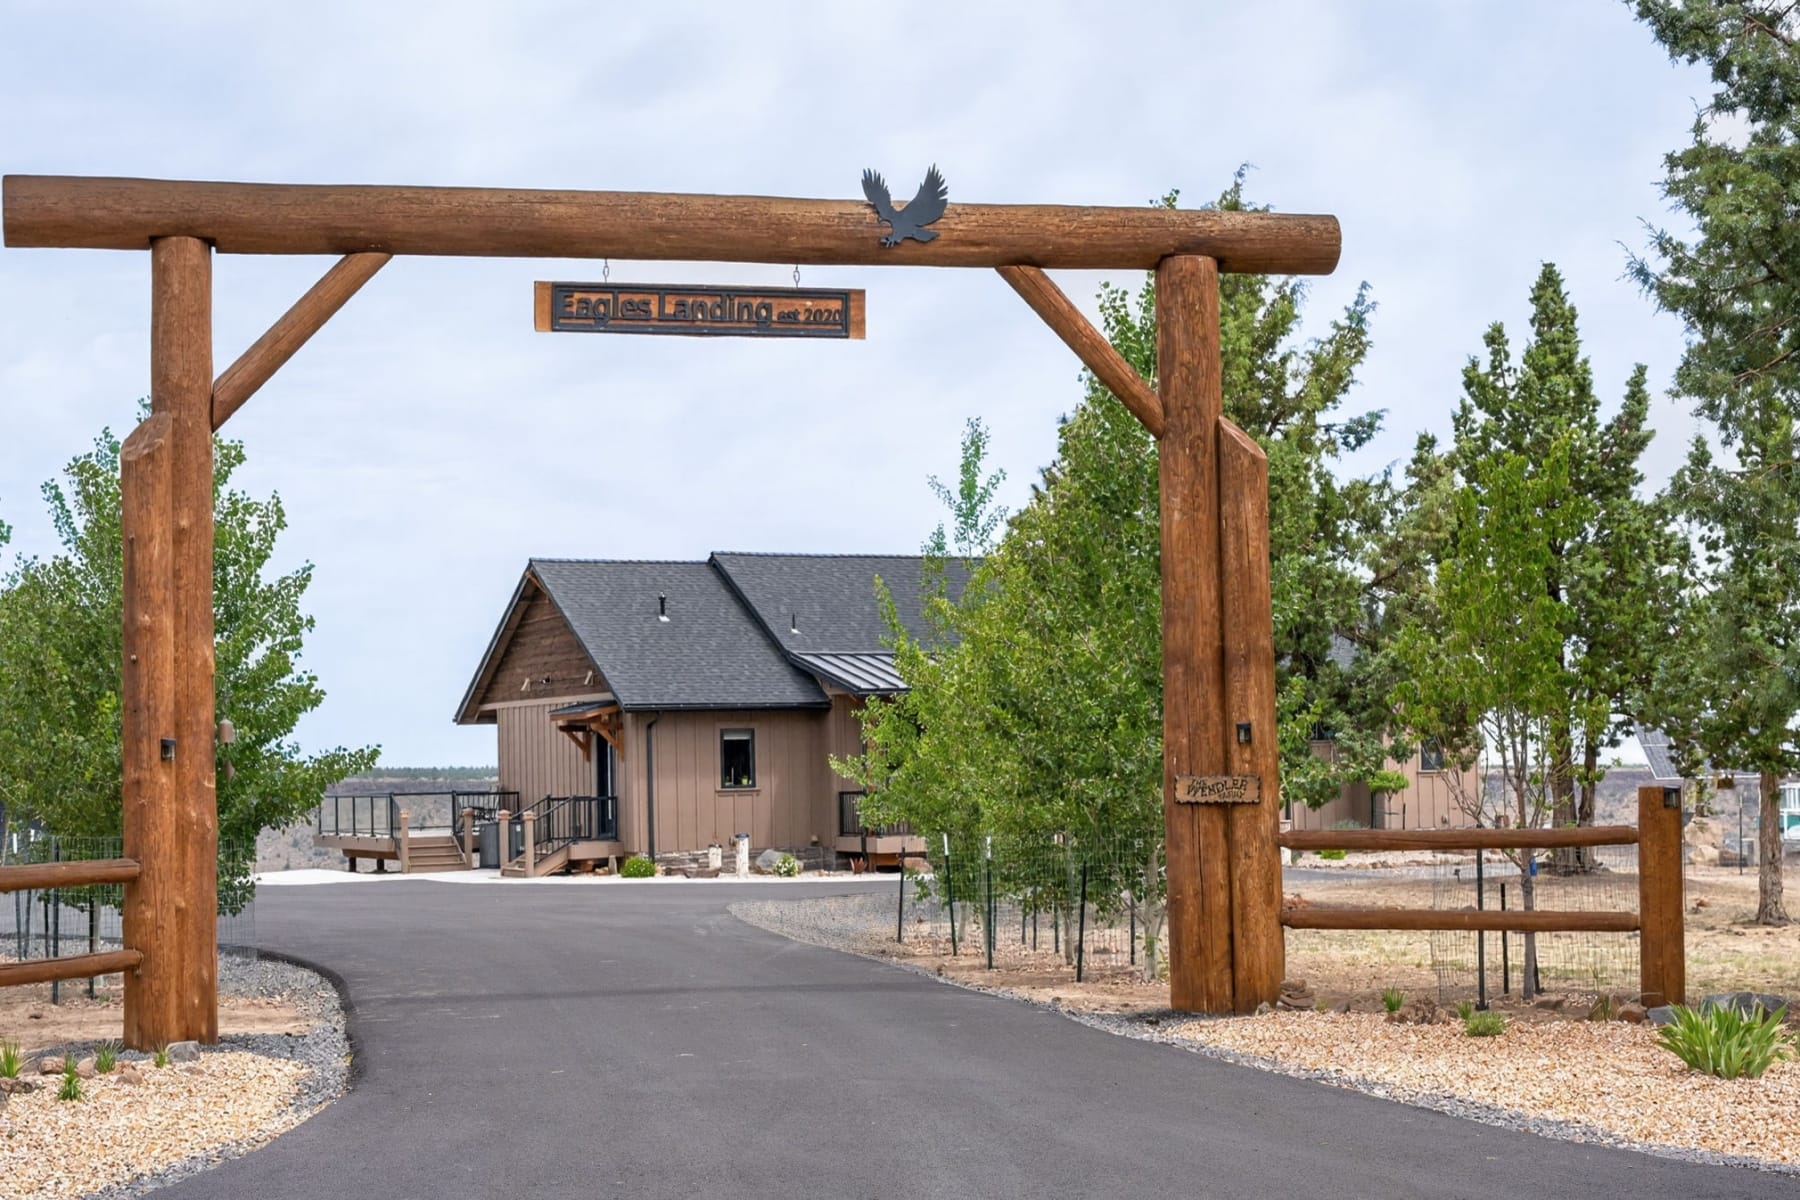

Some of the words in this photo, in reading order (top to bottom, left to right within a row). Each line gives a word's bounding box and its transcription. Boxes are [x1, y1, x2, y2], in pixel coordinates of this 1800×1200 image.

[560, 291, 652, 325] Eagles
[659, 292, 772, 327] Landing
[777, 309, 800, 322] est
[804, 308, 842, 323] 2020
